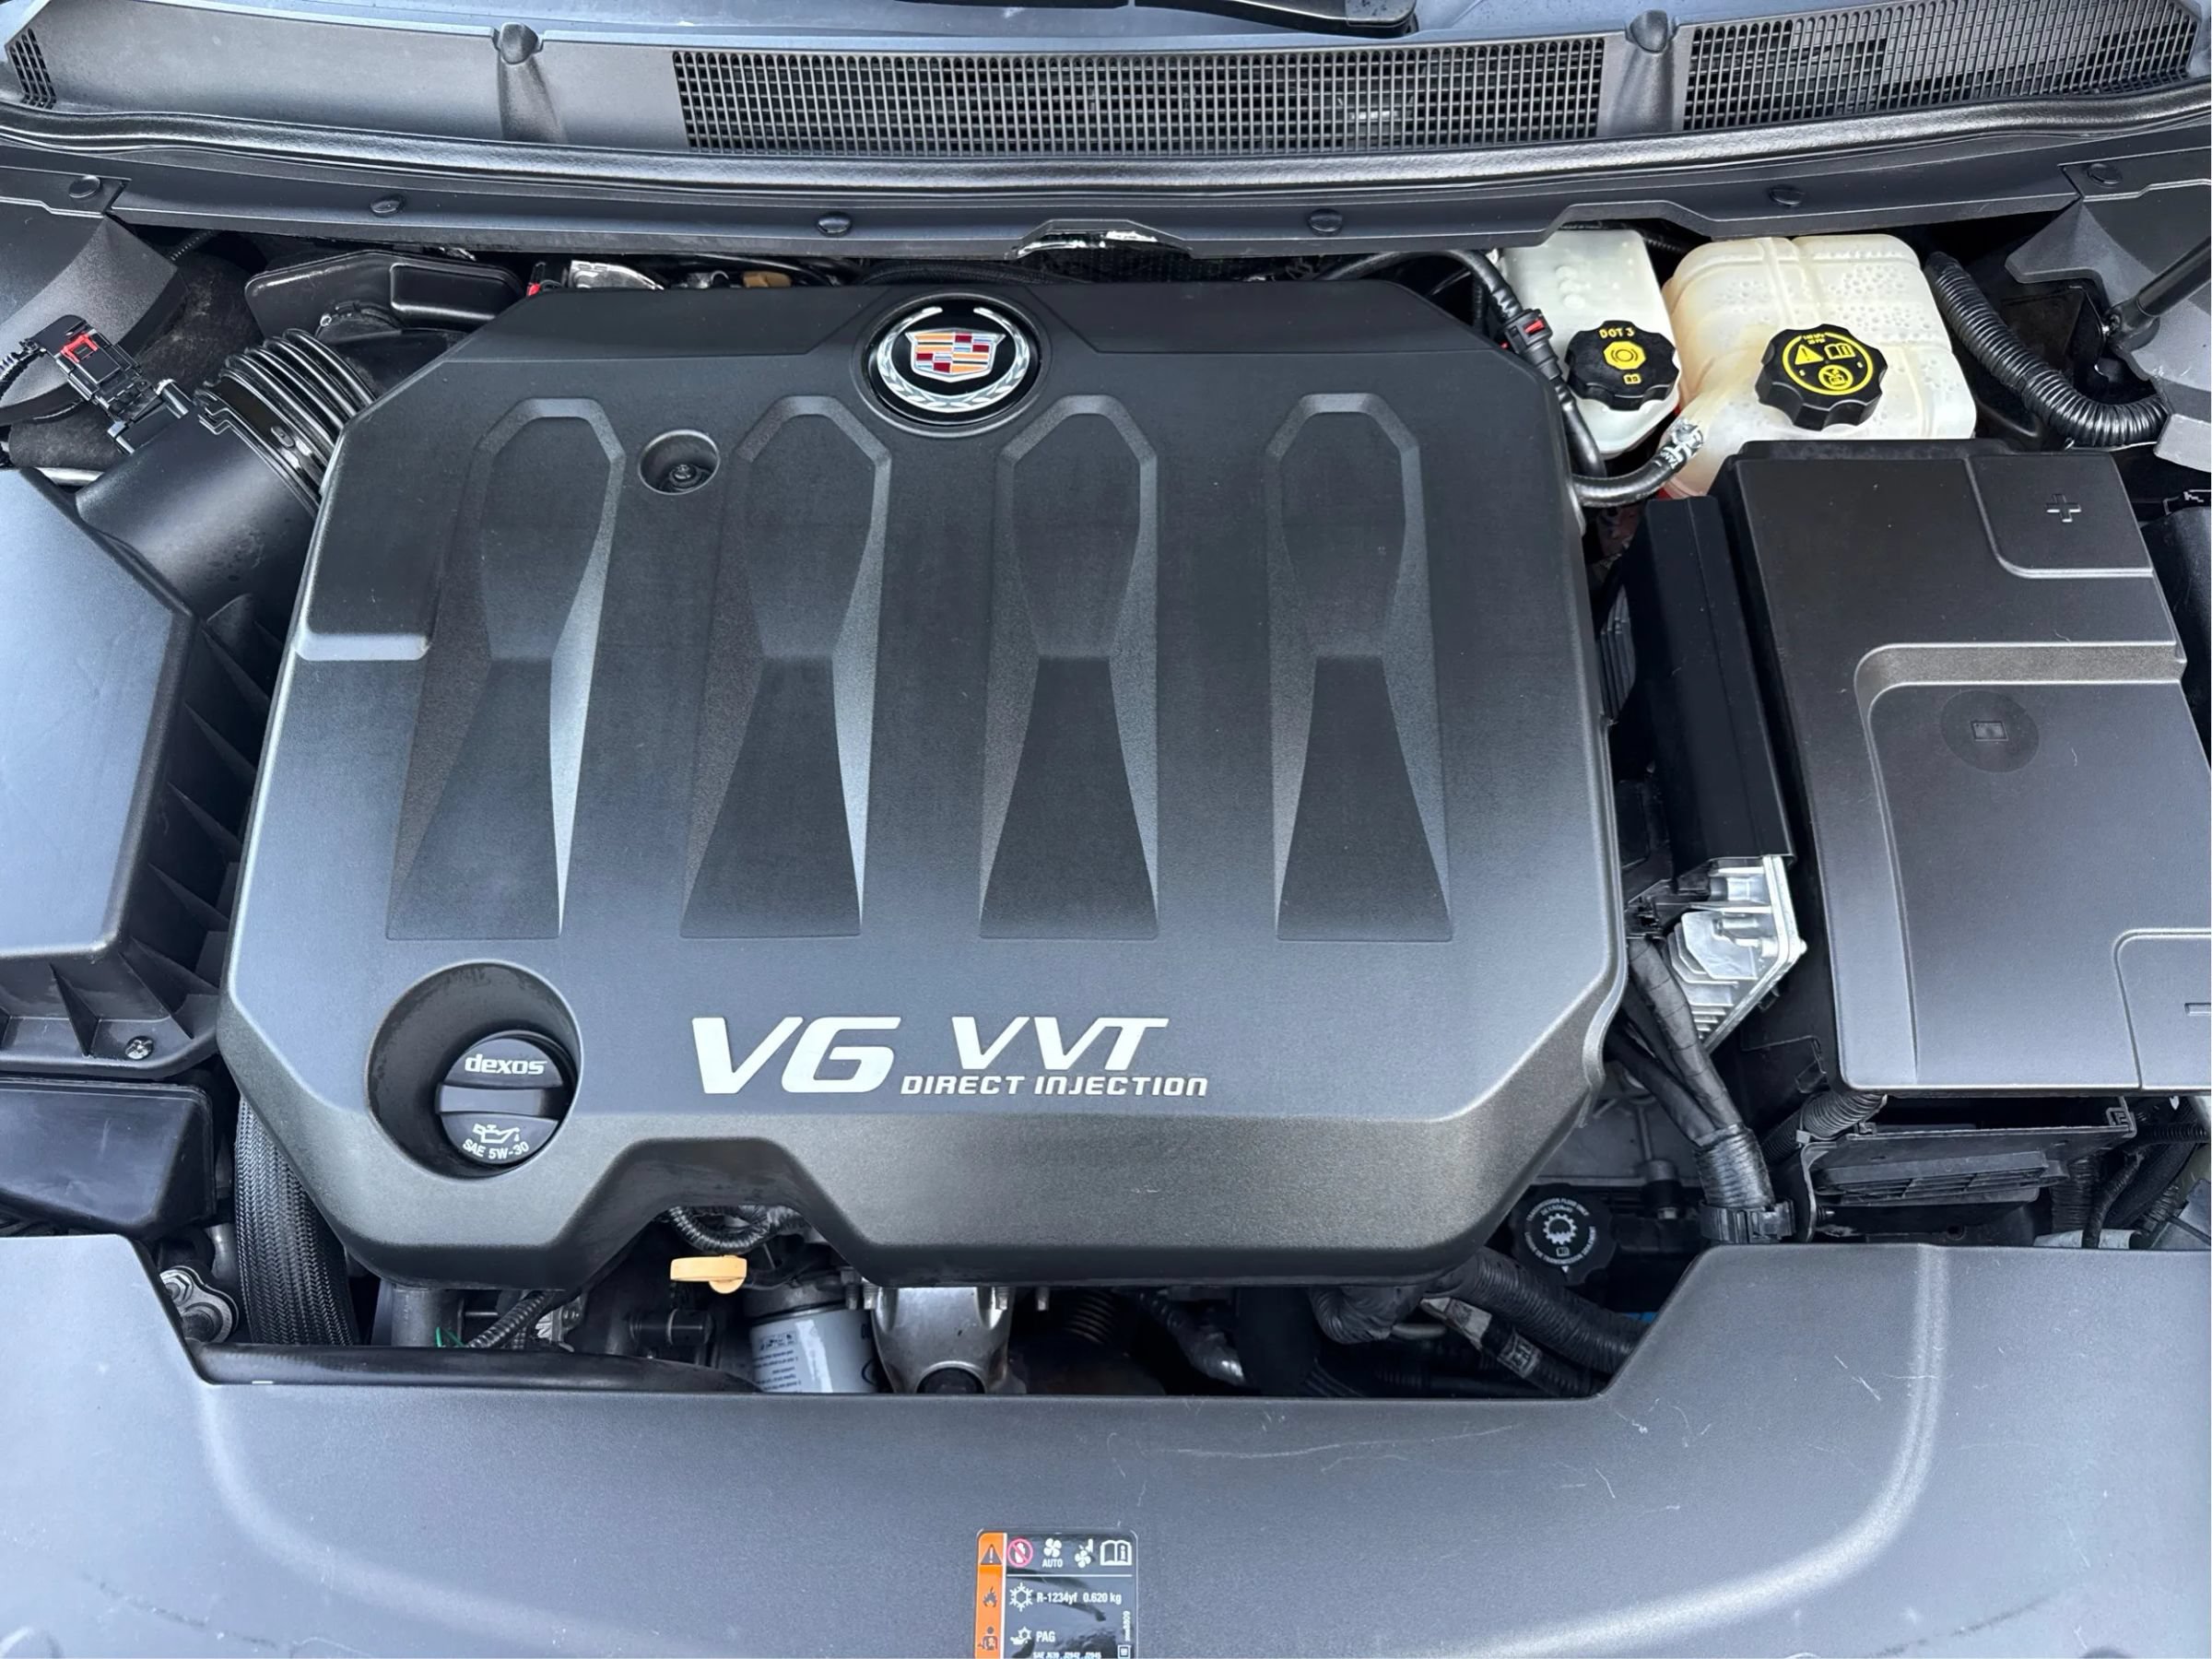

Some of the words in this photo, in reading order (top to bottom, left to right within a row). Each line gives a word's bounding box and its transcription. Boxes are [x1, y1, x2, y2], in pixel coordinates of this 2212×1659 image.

[1599, 327, 1623, 339] DOT
[1625, 327, 1635, 337] 3
[691, 1016, 901, 1094] V6
[951, 1016, 1170, 1071] VVT
[465, 1053, 547, 1075] dexos
[900, 1075, 1025, 1096] DIRECT
[1034, 1076, 1208, 1097] INJECTION
[463, 1138, 486, 1158] SAE
[488, 1141, 529, 1159] 5W-30
[1041, 1559, 1064, 1568] AUTO
[1036, 1593, 1077, 1606] R-1234yf
[1083, 1593, 1108, 1603] 0.620
[1110, 1593, 1122, 1605] kg
[1036, 1630, 1056, 1643] PAG
